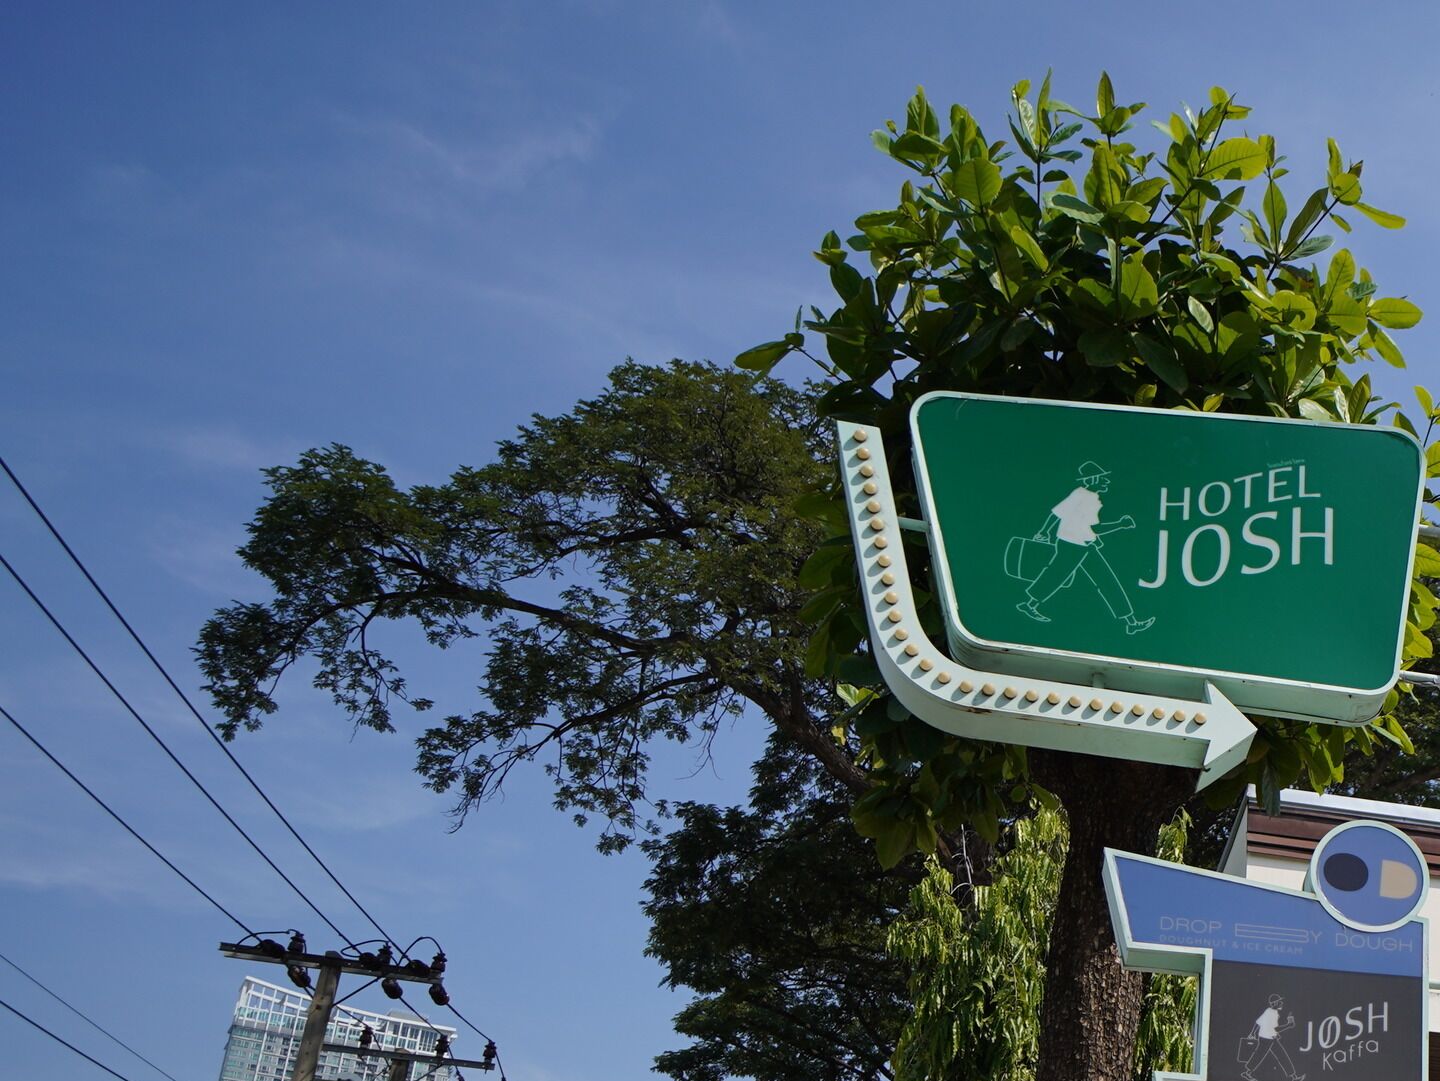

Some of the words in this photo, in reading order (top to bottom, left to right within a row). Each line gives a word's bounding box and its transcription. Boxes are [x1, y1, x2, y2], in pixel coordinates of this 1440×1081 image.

[1159, 464, 1321, 521] HOTEL
[1138, 507, 1334, 589] JOSH
[1159, 916, 1222, 934] DROP
[1335, 932, 1413, 953] DOUGH
[1159, 935, 1227, 948] DOUGHNUT
[1243, 942, 1260, 951] ICE
[1265, 943, 1303, 955] CREAM
[1299, 1001, 1388, 1052] JOSH
[1322, 1040, 1379, 1072] Kaffa
